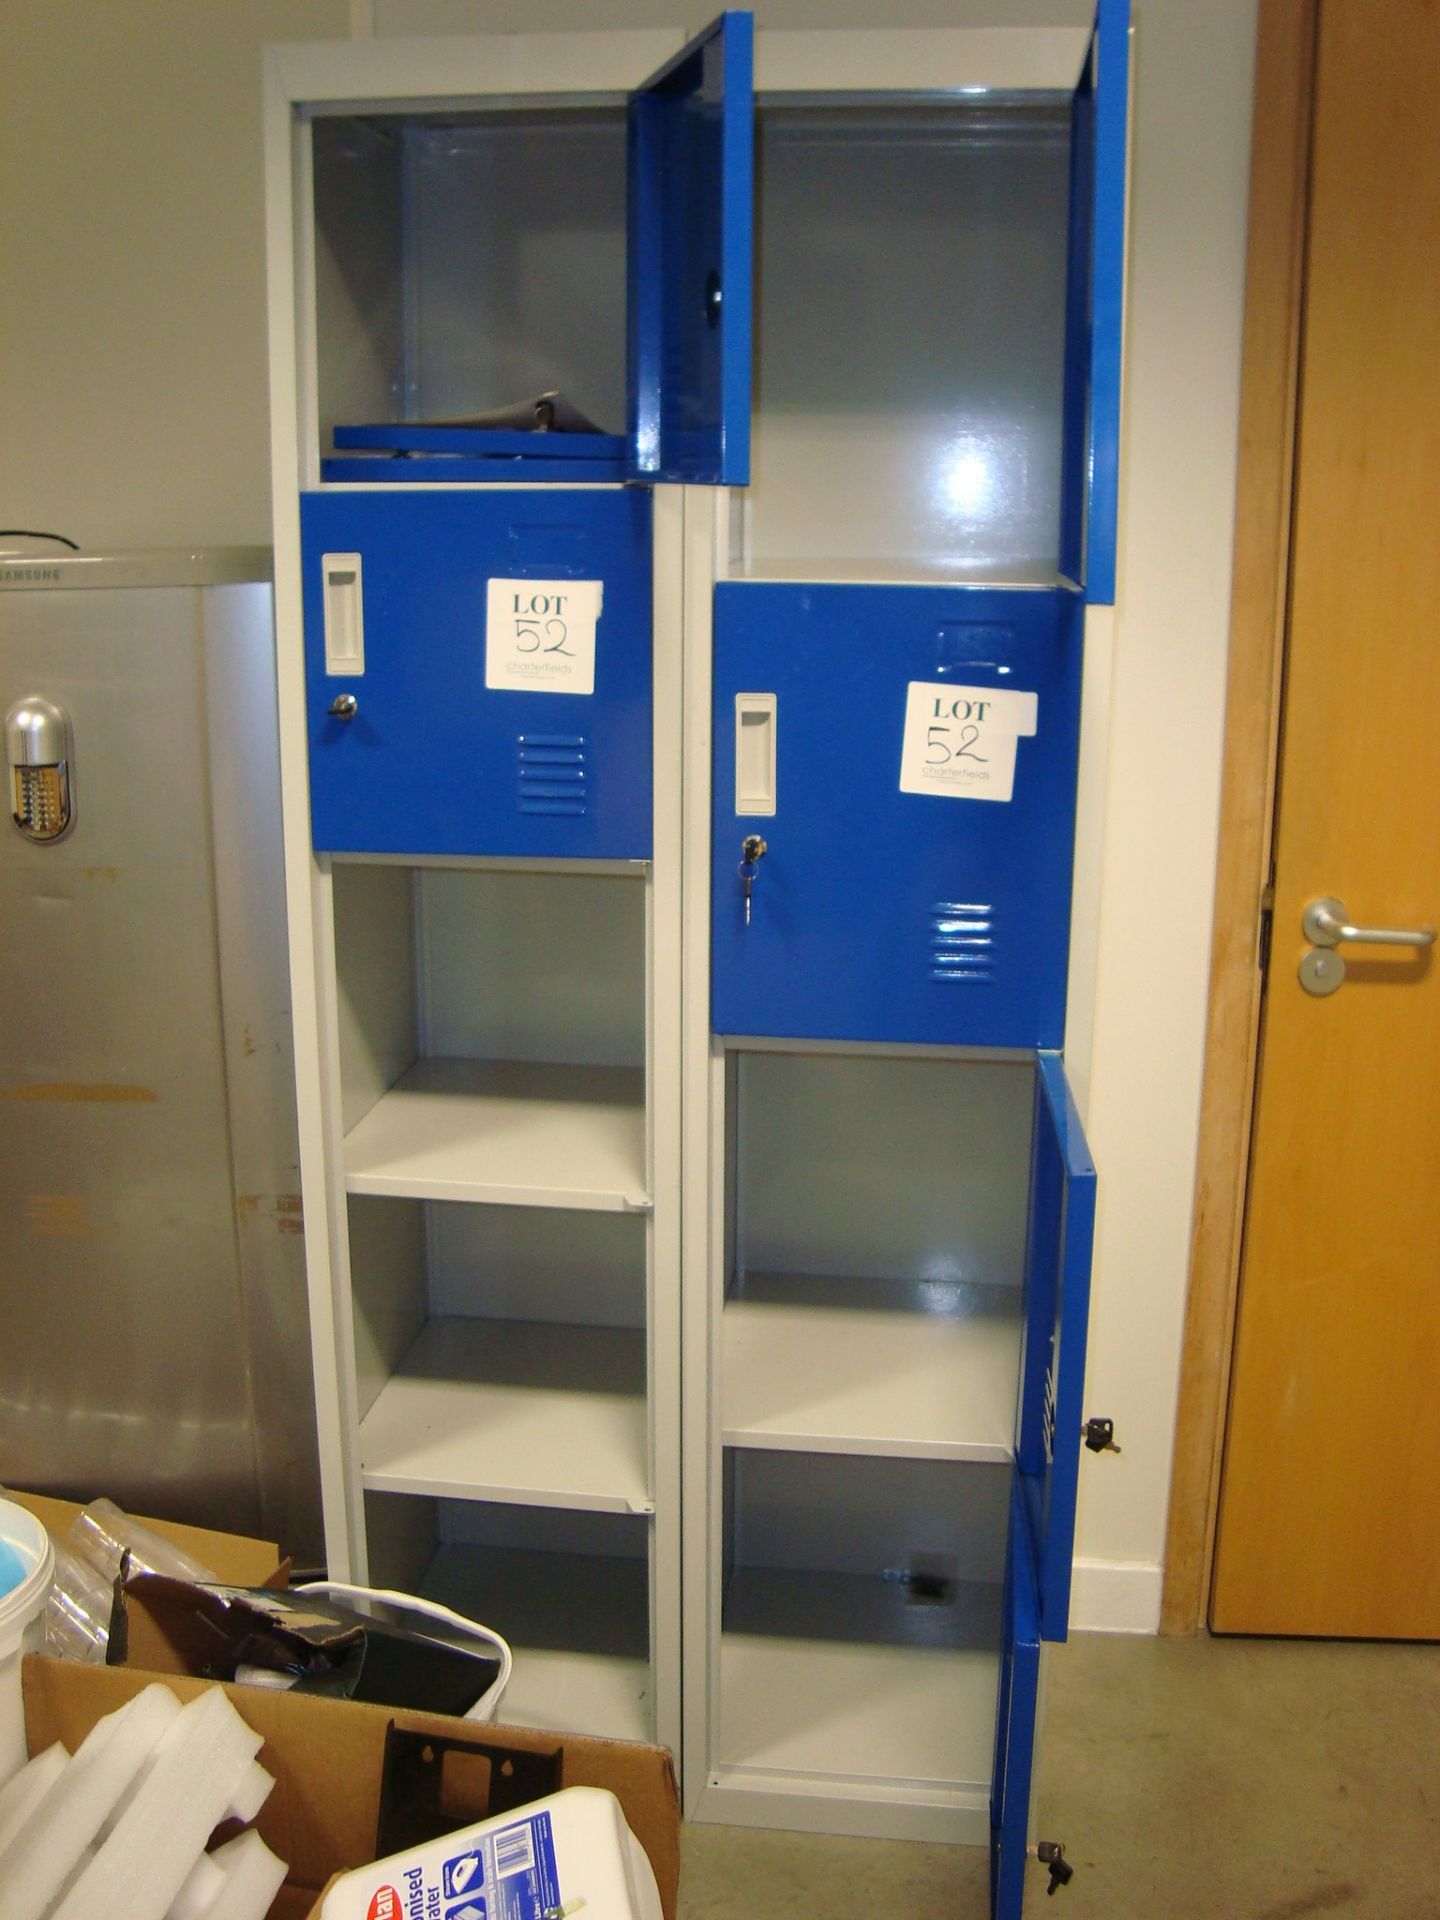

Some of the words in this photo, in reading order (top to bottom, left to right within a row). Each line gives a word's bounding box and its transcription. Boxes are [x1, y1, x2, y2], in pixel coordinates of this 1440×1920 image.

[513, 593, 568, 616] LOT
[515, 618, 577, 657] 52
[934, 698, 991, 721] LOT
[925, 724, 990, 765] 52
[425, 1886, 442, 1920] ater
